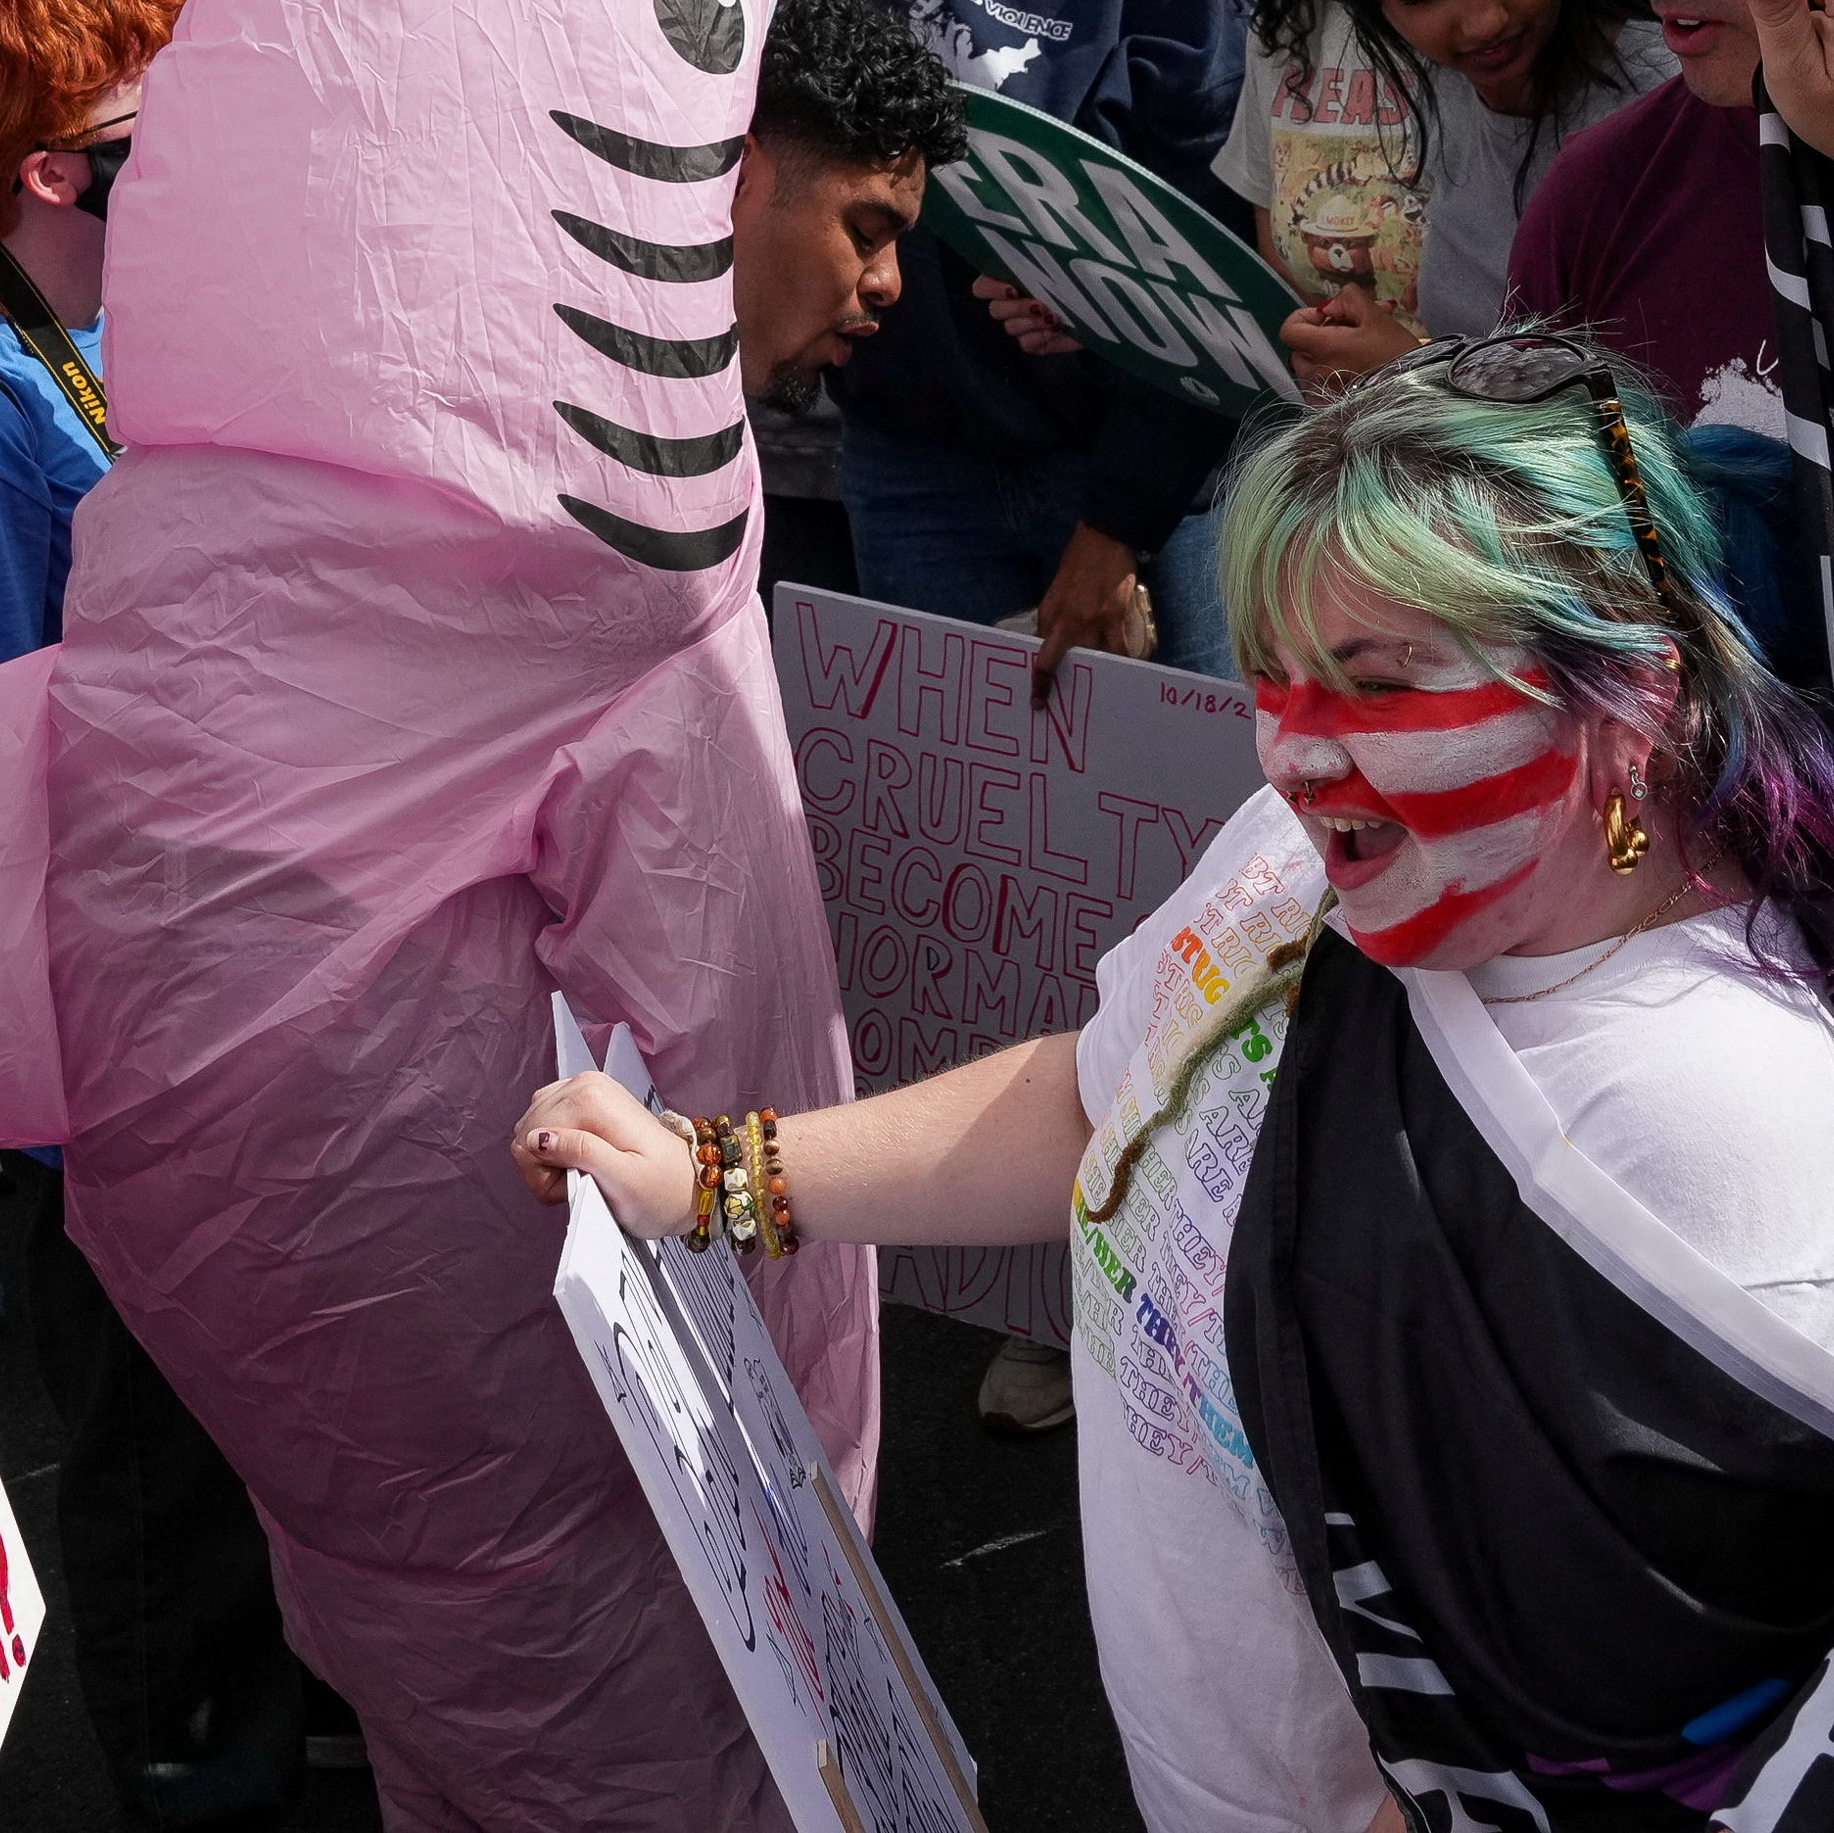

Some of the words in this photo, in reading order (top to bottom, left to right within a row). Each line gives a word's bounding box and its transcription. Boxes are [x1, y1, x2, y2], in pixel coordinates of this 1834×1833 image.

[63, 361, 107, 426] Nikon
[973, 224, 1305, 404] NOW
[796, 602, 1093, 773] WHEN
[1159, 681, 1253, 720] 10/18/2
[807, 814, 1142, 978] BECOME
